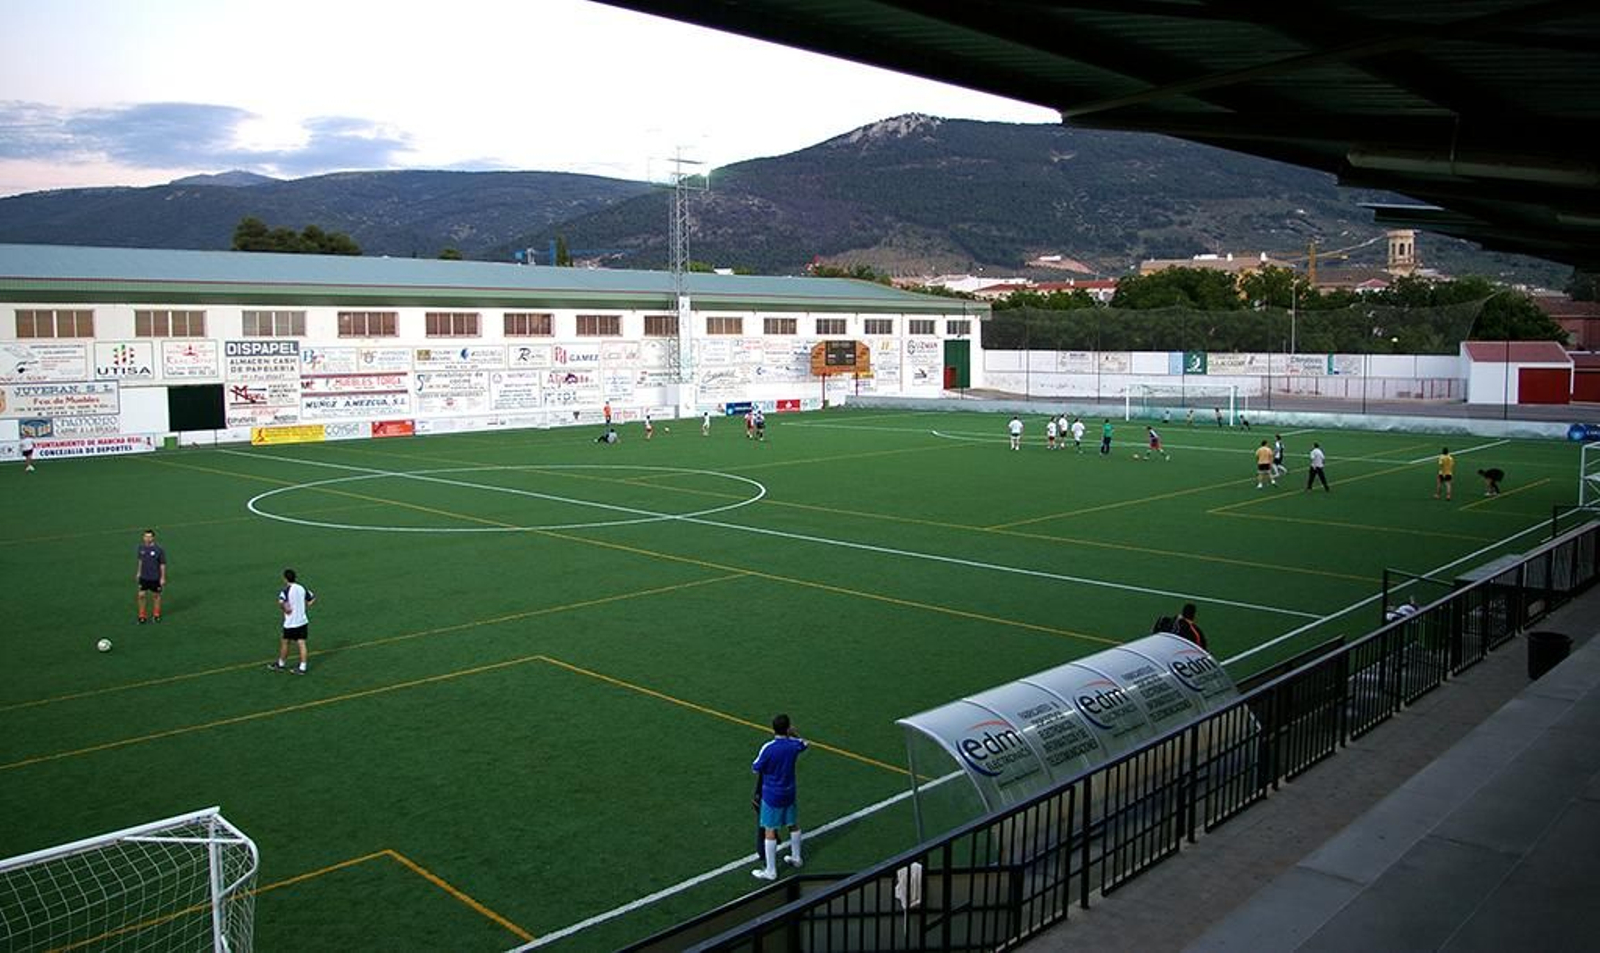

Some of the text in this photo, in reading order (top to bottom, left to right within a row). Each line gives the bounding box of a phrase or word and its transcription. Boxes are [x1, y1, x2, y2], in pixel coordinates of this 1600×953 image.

[227, 342, 298, 355] DISPAPEL
[230, 358, 271, 366] ALMACEN
[97, 366, 152, 376] UTISA
[97, 445, 133, 454] DEPORTES
[1172, 656, 1217, 679] edm
[1078, 688, 1129, 715] edm
[962, 729, 1023, 760] edm
